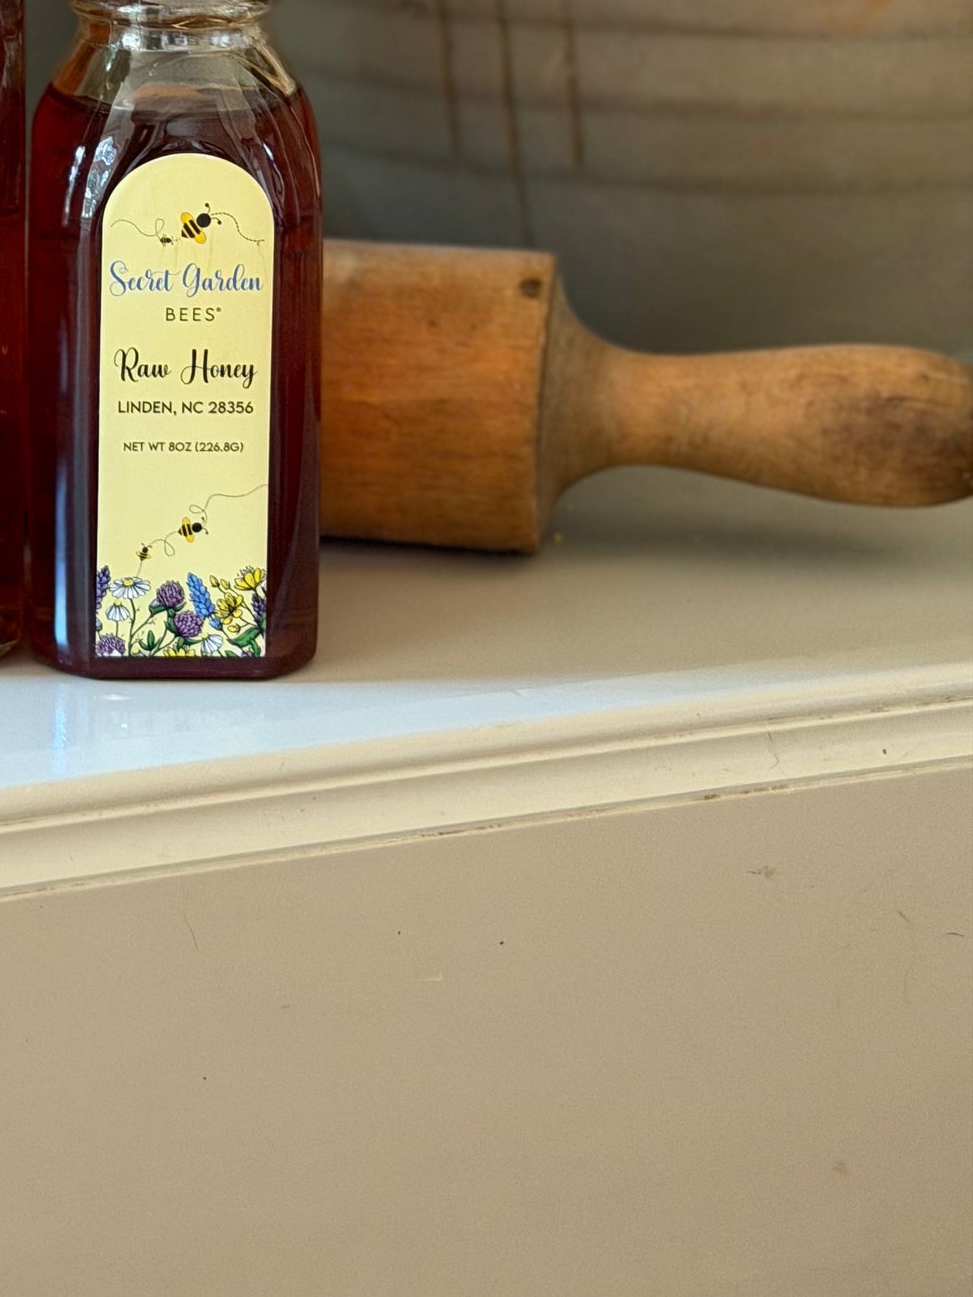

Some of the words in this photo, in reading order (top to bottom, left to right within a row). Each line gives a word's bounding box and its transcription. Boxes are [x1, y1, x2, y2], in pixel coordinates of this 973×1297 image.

[109, 260, 181, 297] Secret
[182, 262, 263, 298] Garden
[114, 347, 172, 383] Raw
[180, 348, 258, 389] Honey
[118, 400, 177, 416] LINDEN,
[182, 401, 203, 414] NC
[208, 401, 254, 414] 28356
[123, 441, 145, 452] NET
[148, 442, 165, 452] WT
[169, 442, 192, 452] 8OZ
[195, 441, 244, 453] (226.8G)
